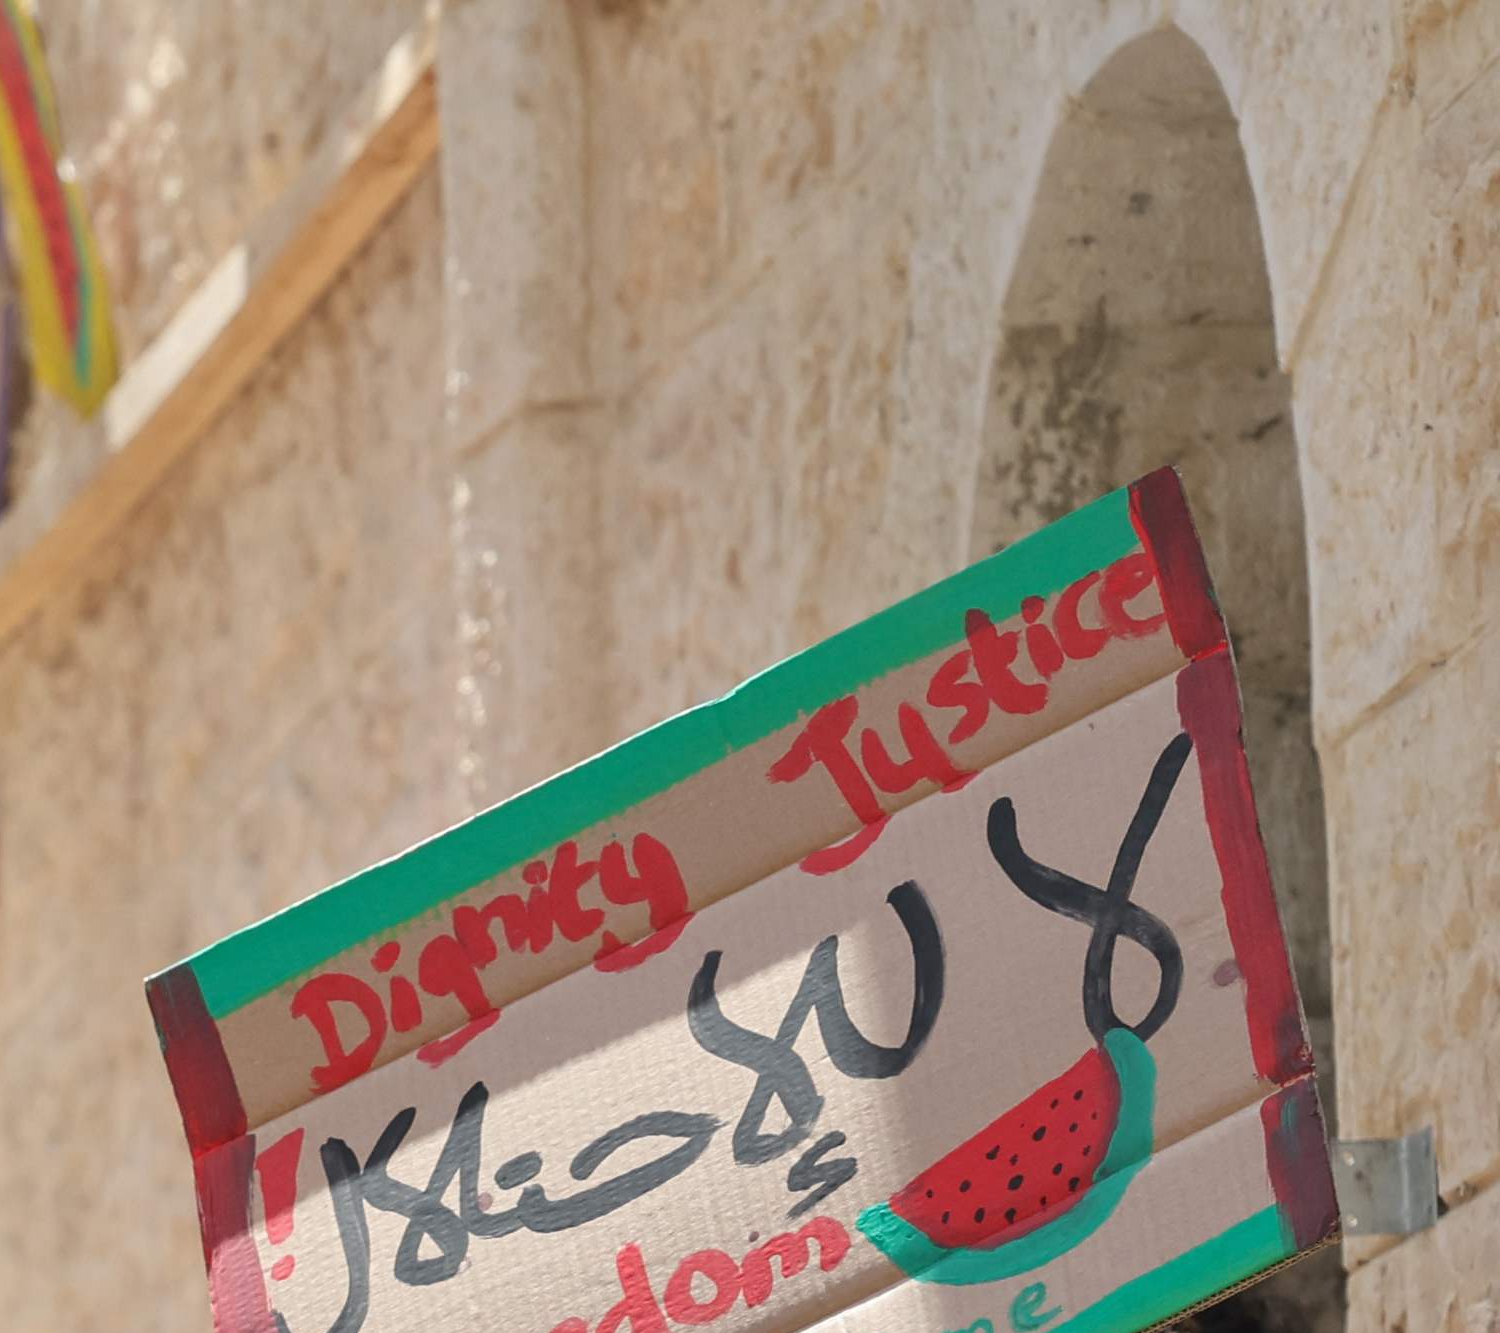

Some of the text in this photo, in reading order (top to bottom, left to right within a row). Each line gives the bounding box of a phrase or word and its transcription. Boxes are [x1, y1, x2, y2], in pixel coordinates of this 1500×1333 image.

[290, 552, 1167, 1095] Dignity Justice
[987, 732, 1194, 1058] لا
